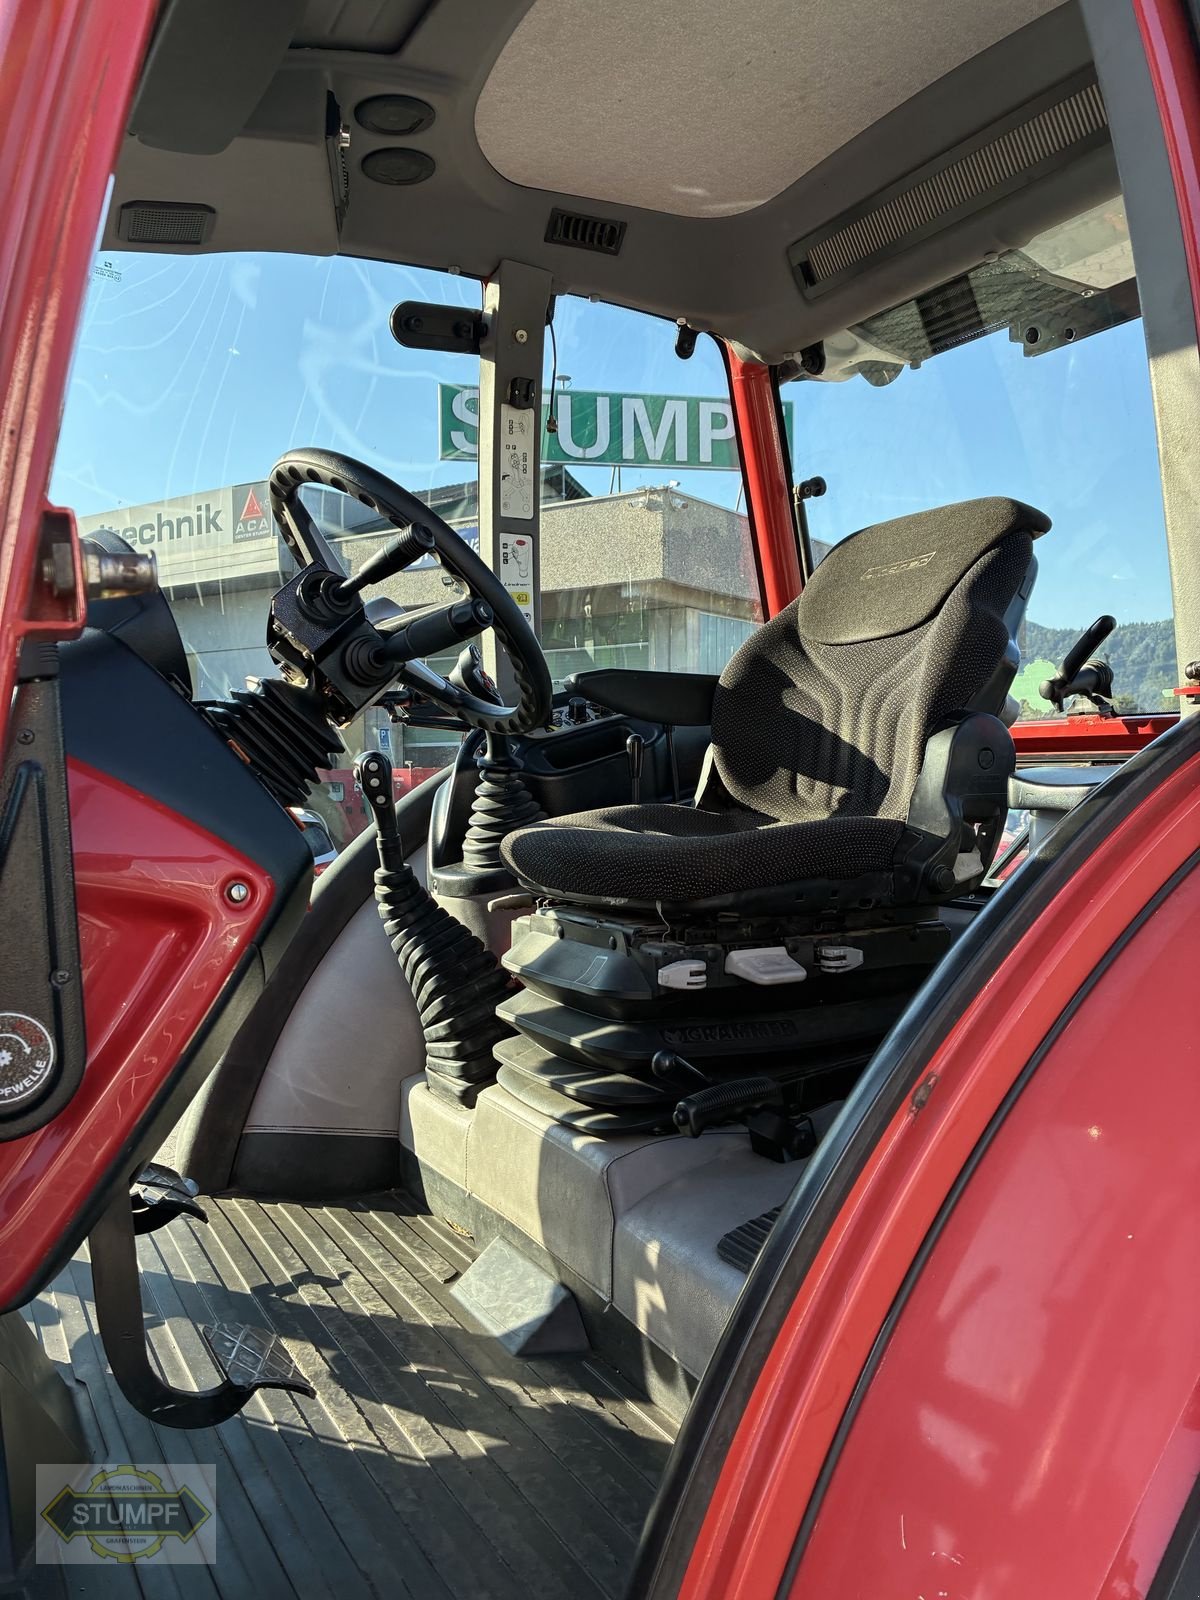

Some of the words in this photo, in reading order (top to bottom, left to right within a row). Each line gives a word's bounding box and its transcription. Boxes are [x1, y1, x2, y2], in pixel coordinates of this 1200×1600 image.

[450, 388, 786, 464] SUMP
[100, 503, 224, 546] echnik
[235, 517, 269, 534] ACA
[687, 1021, 796, 1041] GRAMMER
